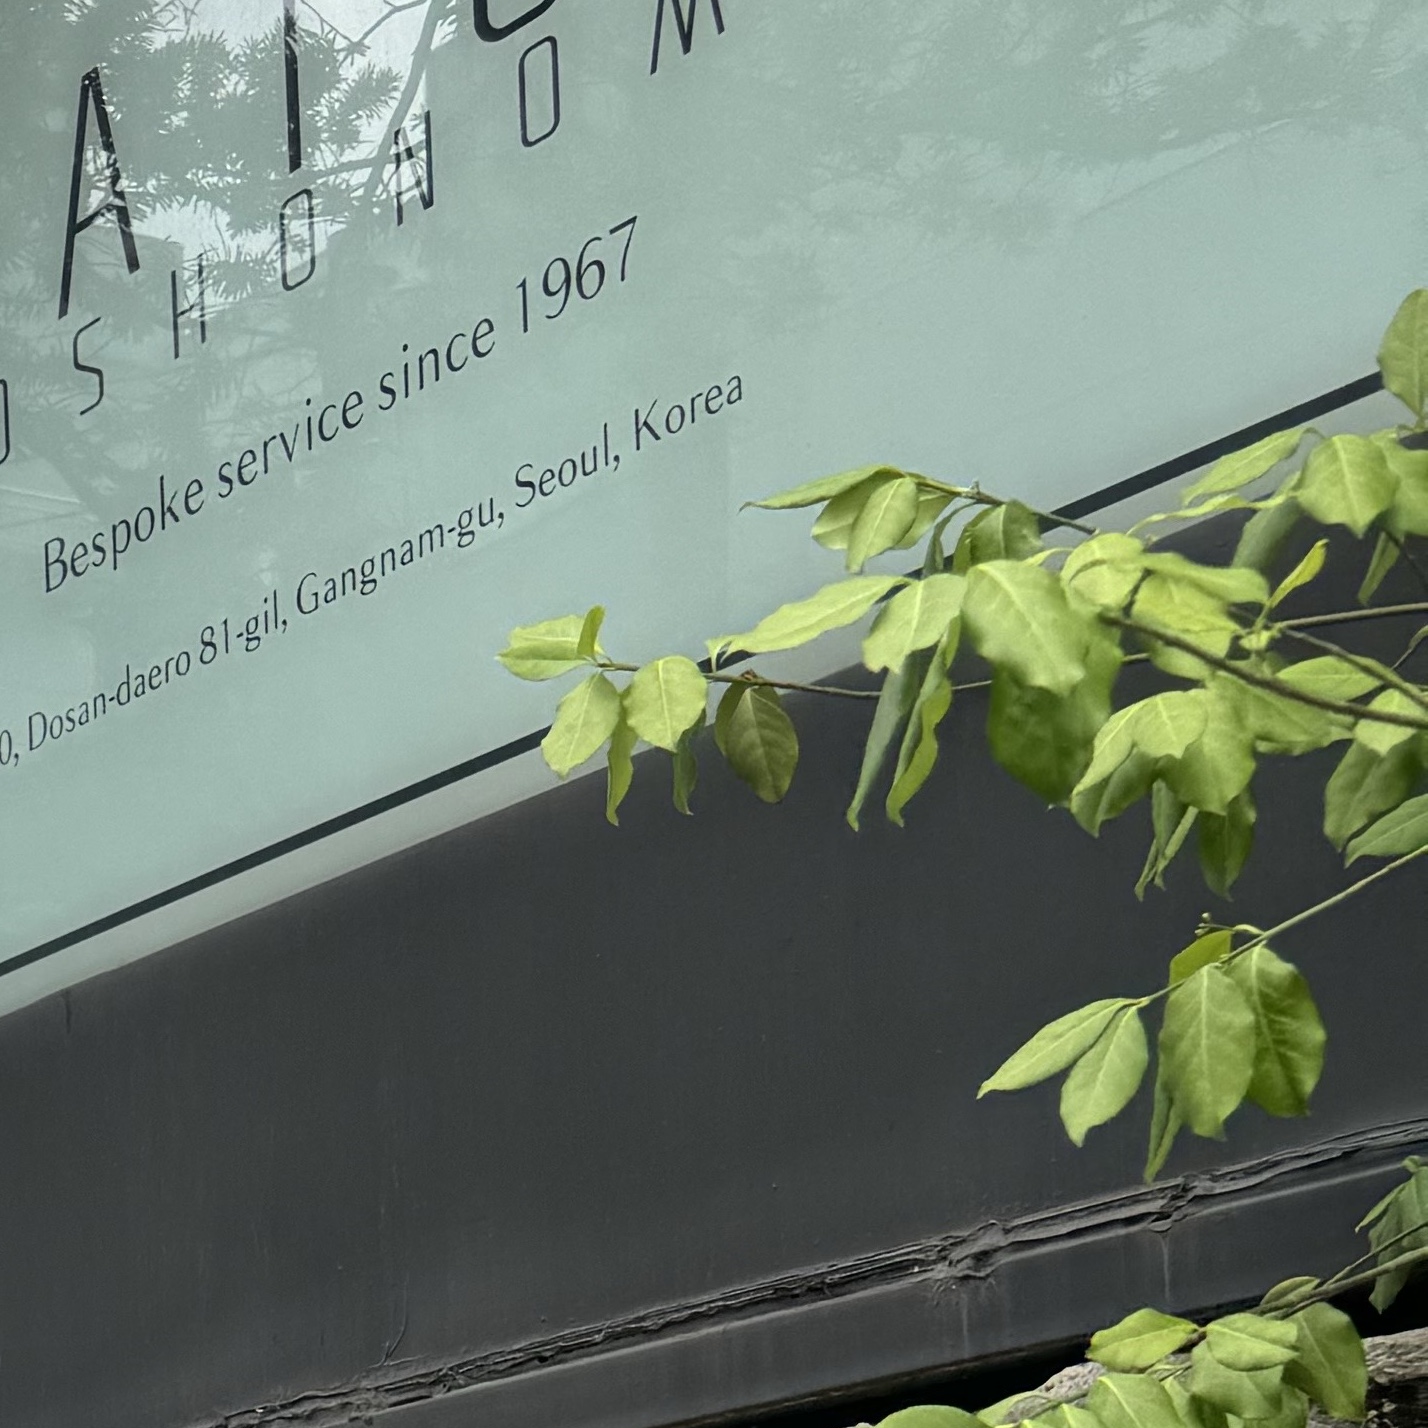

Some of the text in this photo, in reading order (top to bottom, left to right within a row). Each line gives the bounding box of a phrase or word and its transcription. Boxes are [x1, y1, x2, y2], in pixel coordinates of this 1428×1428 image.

[26, 650, 191, 752] Dosan-daero
[198, 590, 289, 664] 81-gil,
[295, 495, 506, 616] Gangnam-gu,
[514, 422, 621, 509] Seoul,
[634, 374, 744, 454] Korea
[44, 215, 638, 593] Bespoke service since 1967
